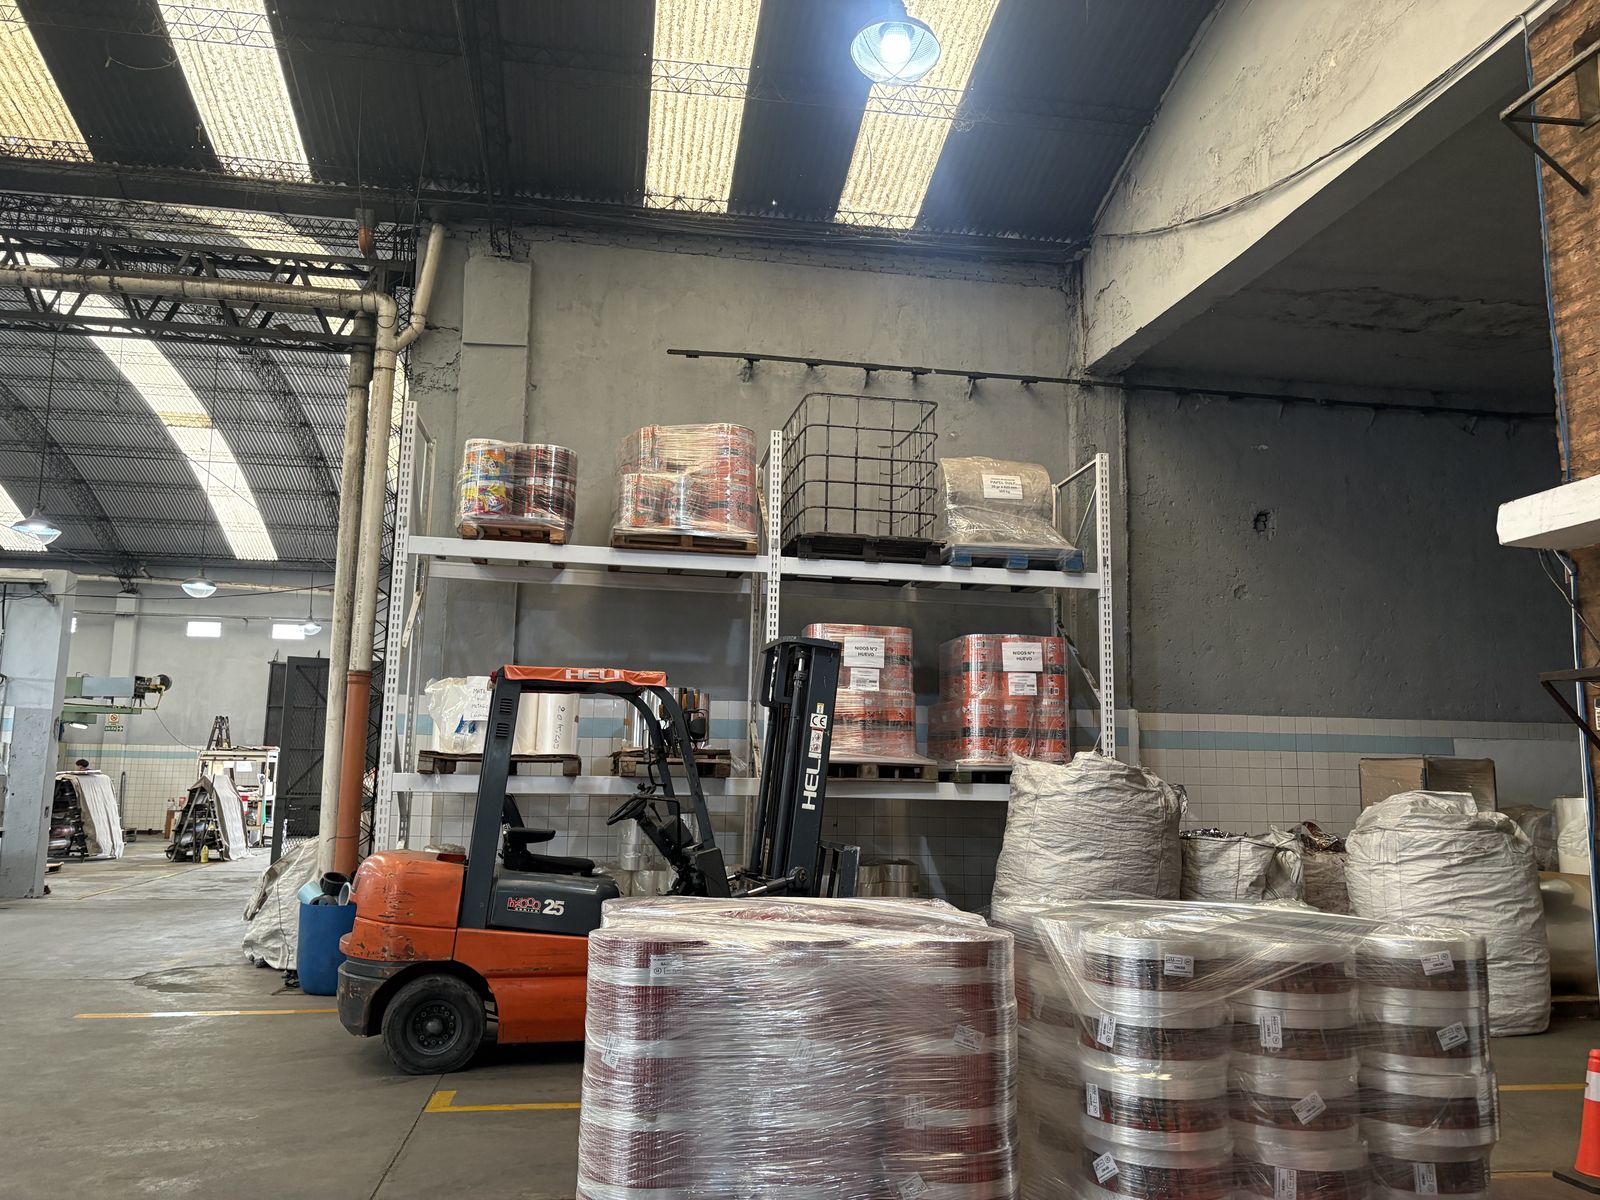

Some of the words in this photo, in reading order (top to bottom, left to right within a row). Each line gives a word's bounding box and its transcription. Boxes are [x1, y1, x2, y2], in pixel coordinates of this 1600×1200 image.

[566, 669, 620, 680] HELI
[801, 753, 822, 811] HELI
[542, 899, 565, 916] 25
